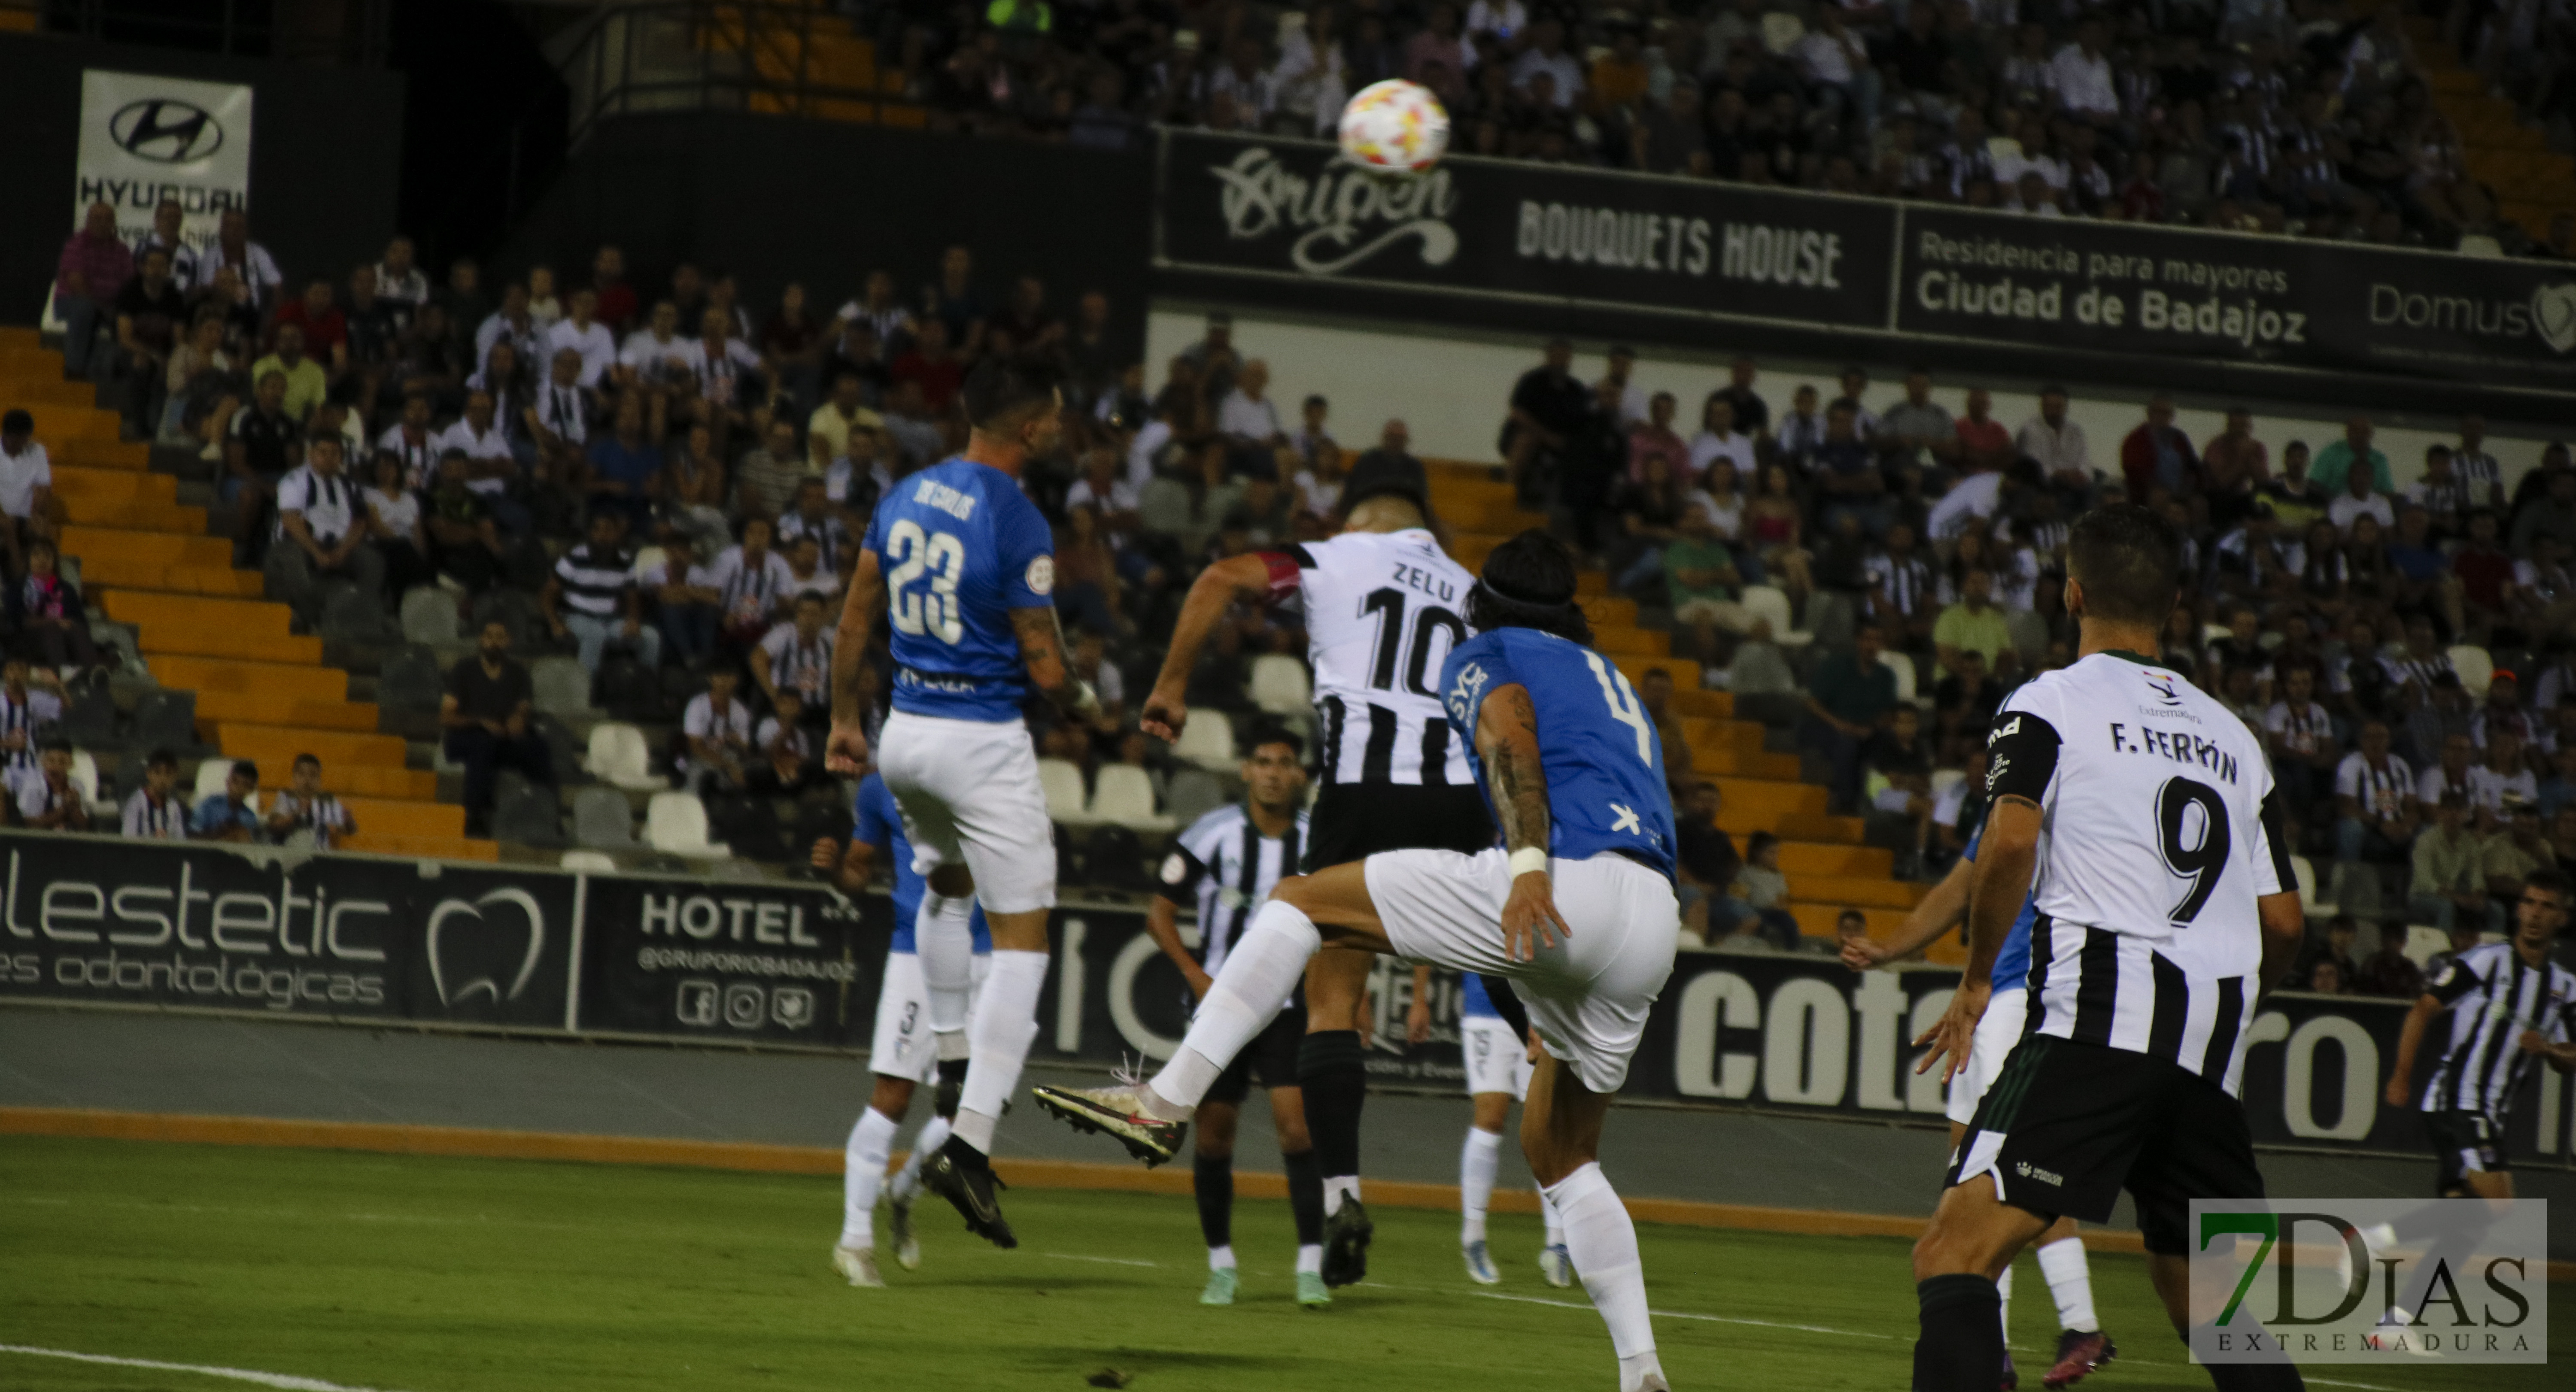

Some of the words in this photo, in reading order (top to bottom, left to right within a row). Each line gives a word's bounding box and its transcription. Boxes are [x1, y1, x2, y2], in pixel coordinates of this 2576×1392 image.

[1517, 199, 1712, 276] BOUQUETS
[1722, 221, 1842, 290] HOUSE
[1918, 230, 2080, 274] Residencia
[2087, 251, 2154, 281] para
[2163, 259, 2289, 294] mayores
[1917, 270, 2063, 321] Ciudad
[2075, 286, 2125, 328] de
[2139, 290, 2307, 347] Badajoz
[2369, 282, 2530, 337] Domus
[886, 519, 964, 645] 23
[1392, 561, 1454, 602] ZELU
[1358, 586, 1467, 699] 10
[1449, 662, 1481, 721] SYC
[1581, 649, 1653, 768] 4
[2110, 722, 2138, 754] F.
[2155, 775, 2231, 928] 9
[0, 847, 392, 961] lestetic
[641, 893, 821, 947] HOTEL
